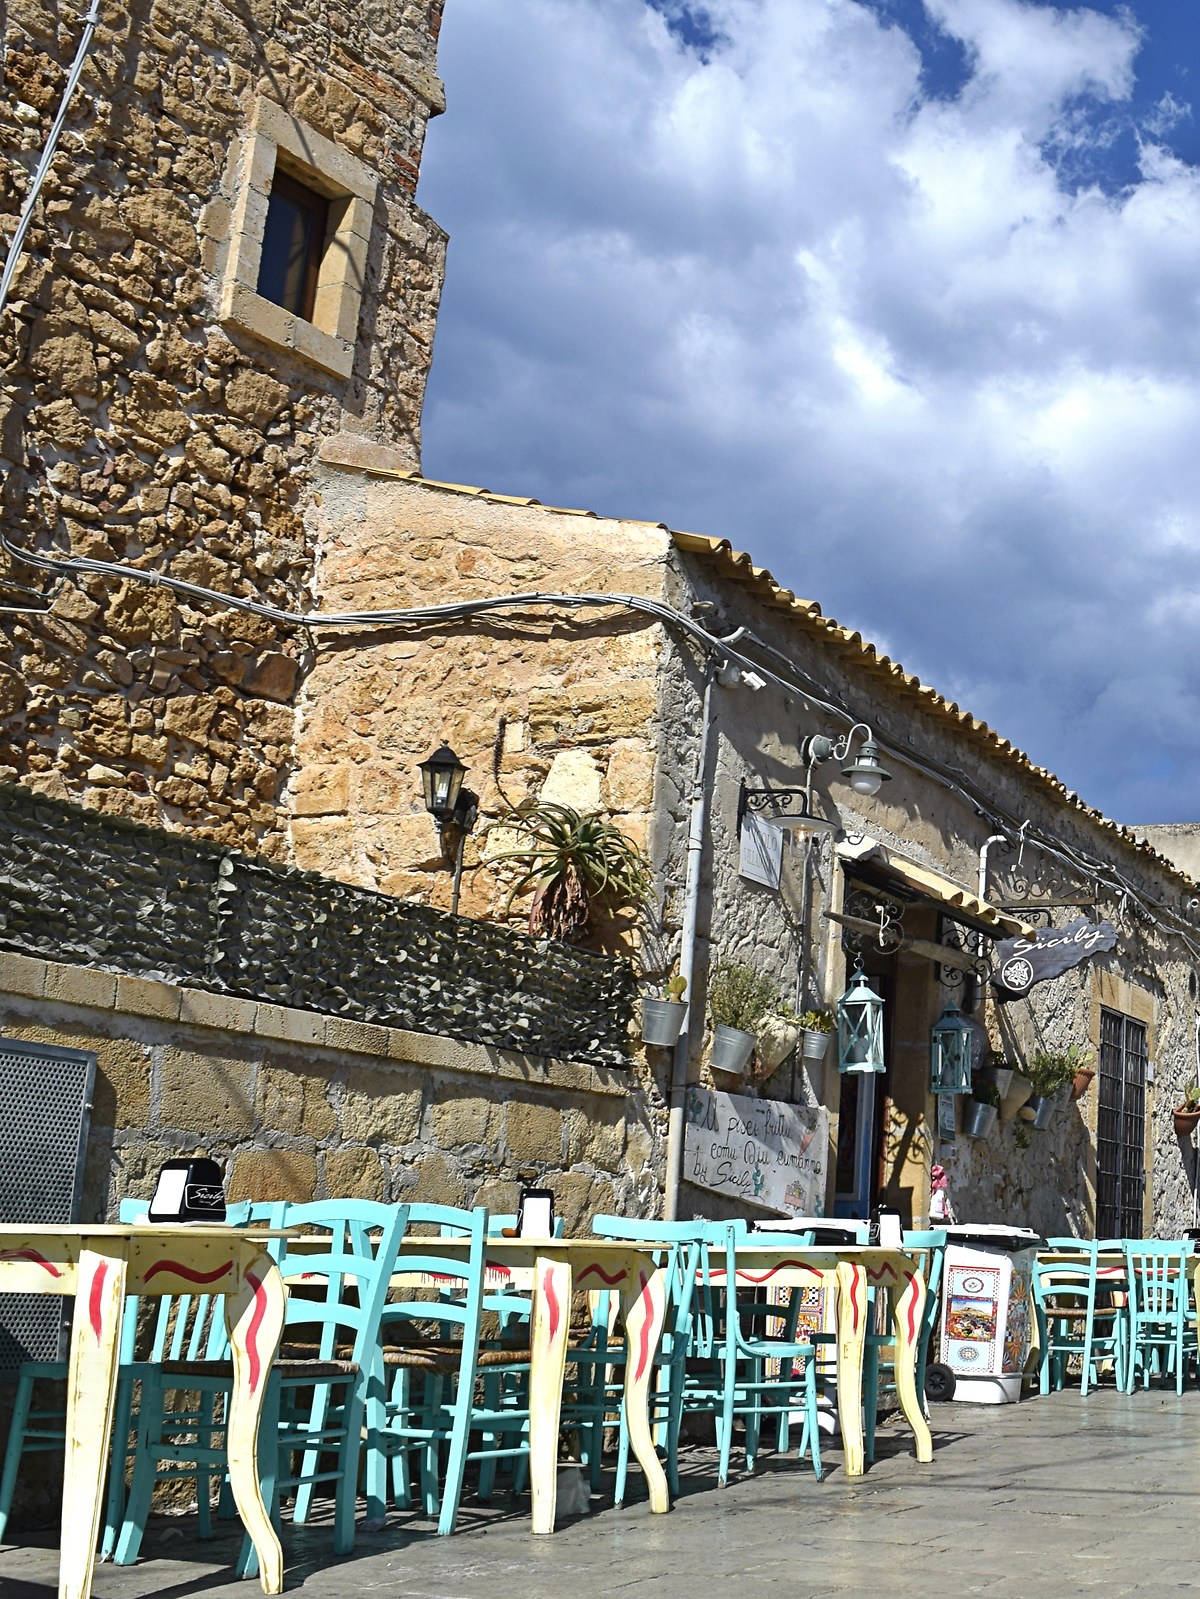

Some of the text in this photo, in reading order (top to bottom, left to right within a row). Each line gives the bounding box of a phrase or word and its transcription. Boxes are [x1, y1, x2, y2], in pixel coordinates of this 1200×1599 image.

[1013, 925, 1104, 957] Sicily
[693, 1148, 752, 1198] by Sicily
